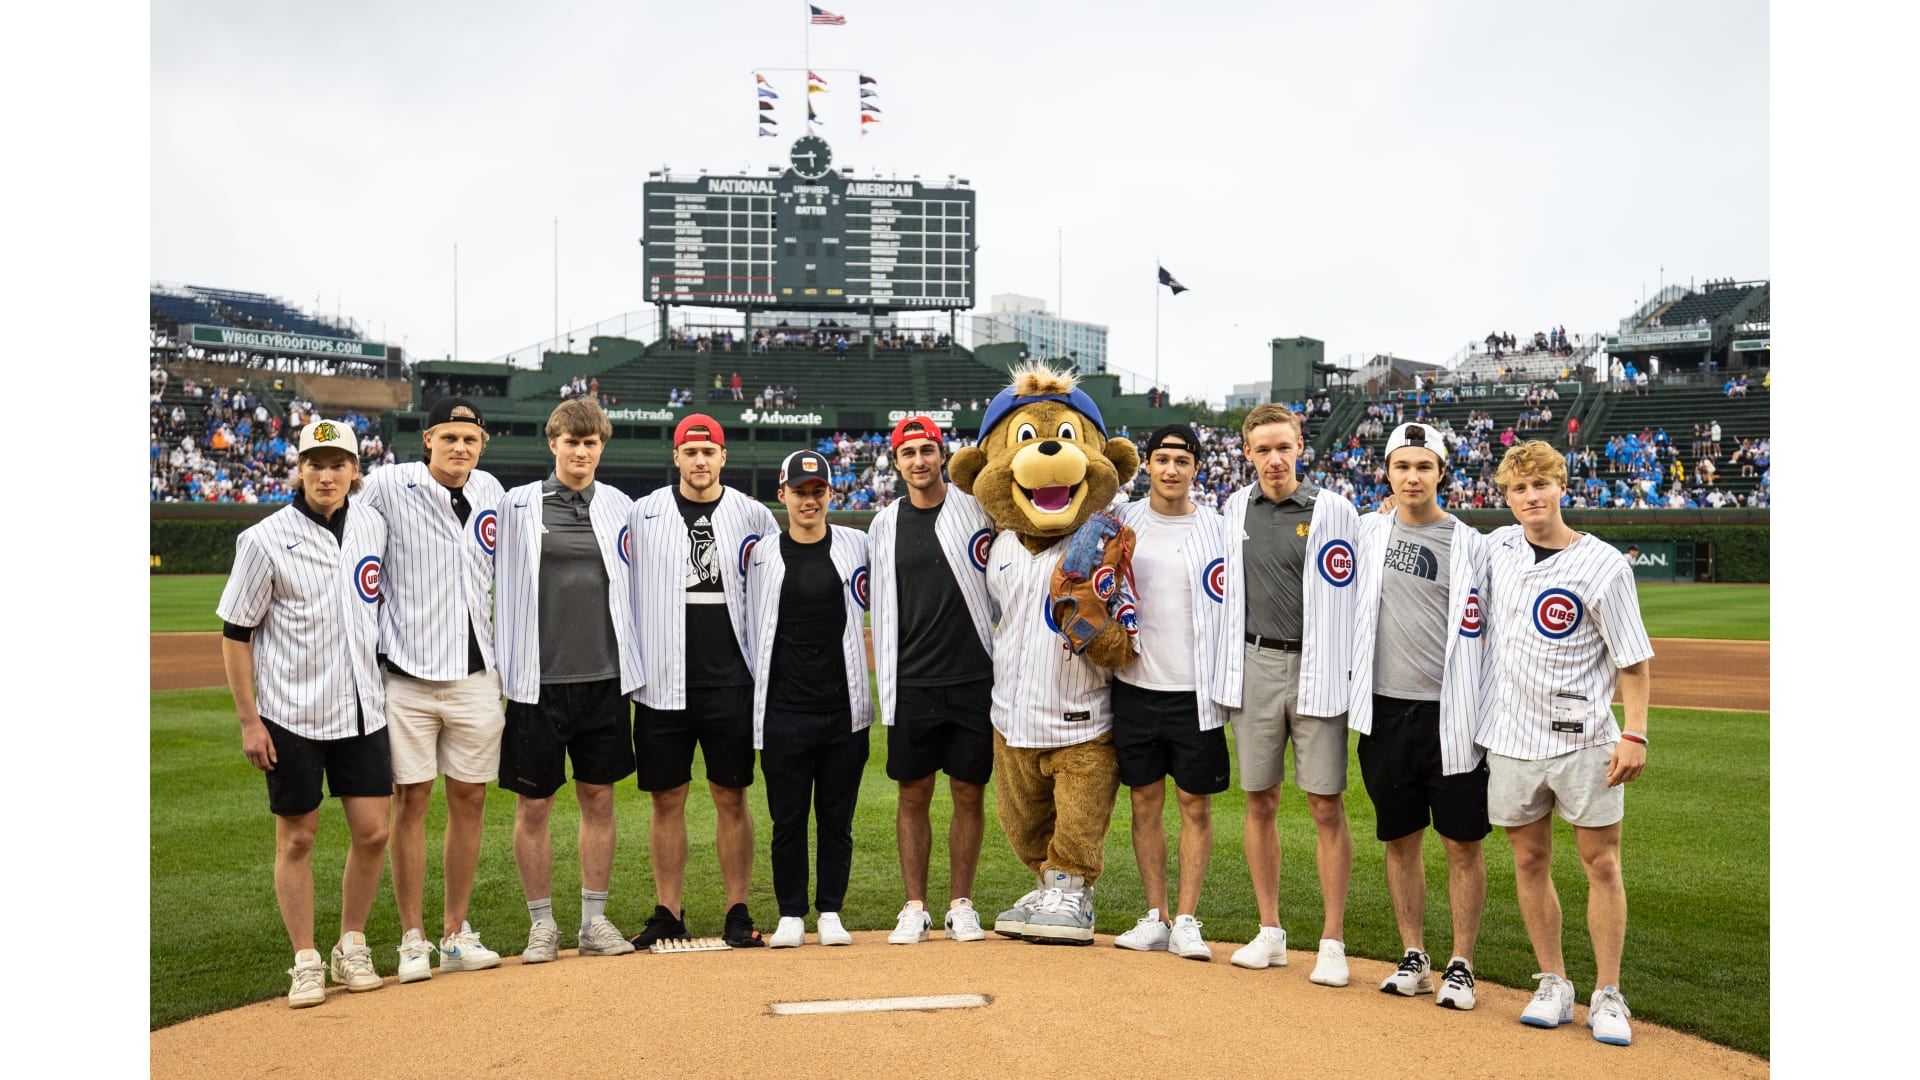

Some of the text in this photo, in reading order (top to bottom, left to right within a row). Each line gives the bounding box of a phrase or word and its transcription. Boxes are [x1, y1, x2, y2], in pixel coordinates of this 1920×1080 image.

[708, 179, 776, 193] NATIONAL
[793, 185, 830, 194] UMPIRES
[846, 183, 913, 197] AMERICAN
[795, 206, 827, 215] BATTER
[603, 408, 674, 420] tastytrade
[760, 411, 822, 425] Advocate
[1397, 540, 1420, 554] THE
[1326, 547, 1351, 579] CUBS
[1385, 548, 1417, 564] ORTH
[1384, 558, 1414, 574] FACE
[361, 563, 380, 596] CUB
[1540, 596, 1575, 631] CUBS
